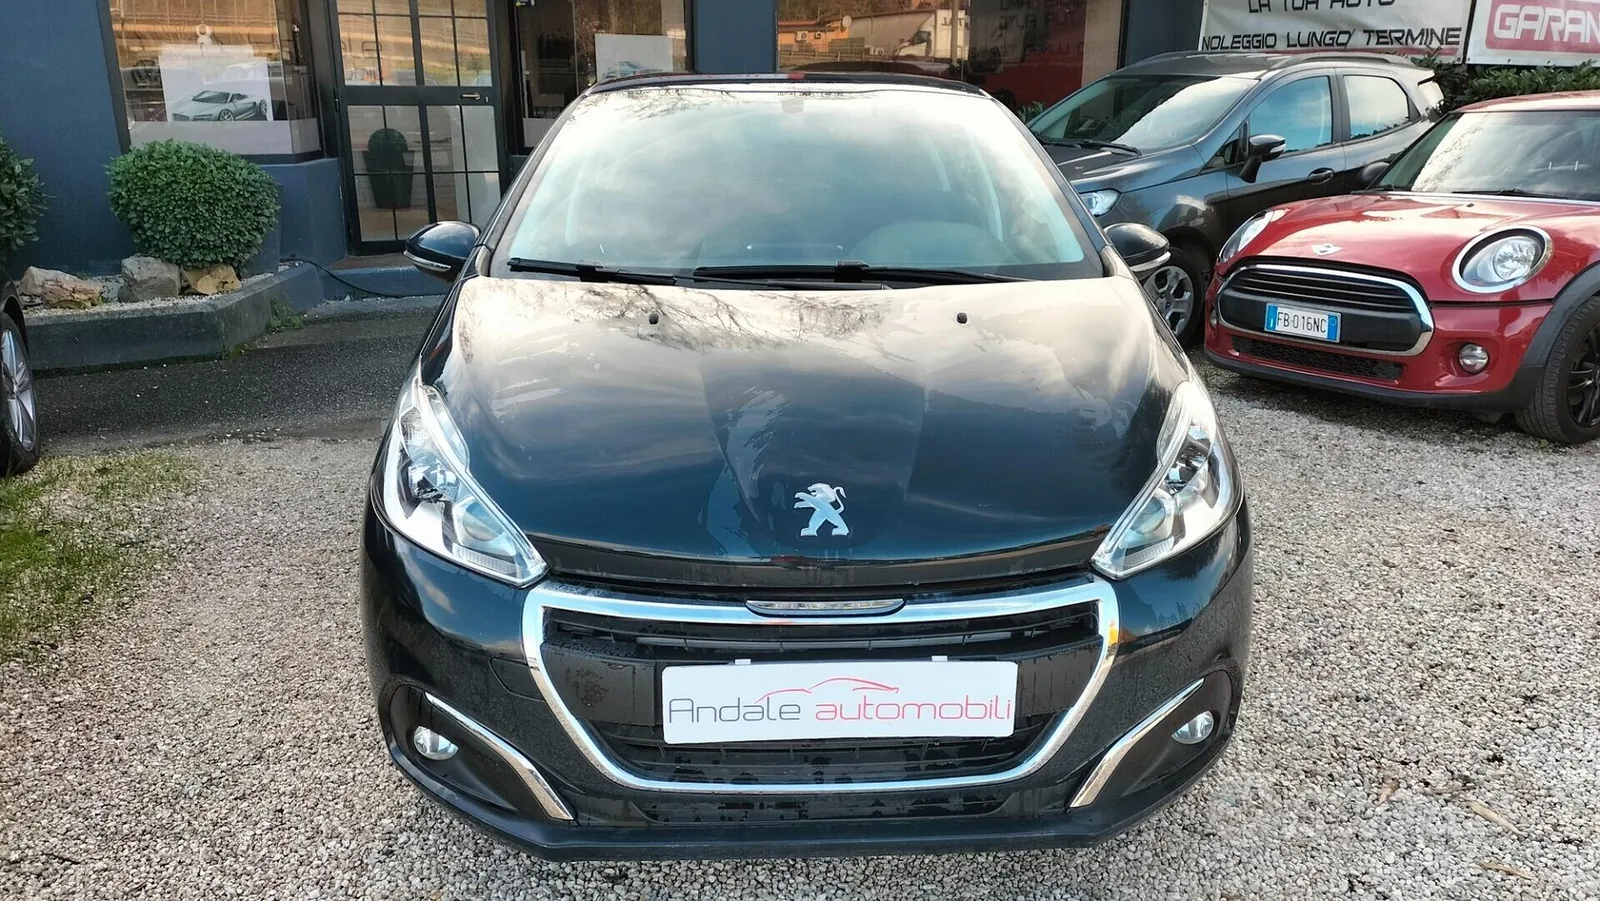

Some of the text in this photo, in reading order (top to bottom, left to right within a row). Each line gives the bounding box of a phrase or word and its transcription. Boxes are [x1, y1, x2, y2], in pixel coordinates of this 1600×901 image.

[1493, 4, 1600, 43] GARAN
[1201, 27, 1462, 51] NOLEGGIO LUNGO TERMINE
[668, 695, 1011, 723] Andale automobili
